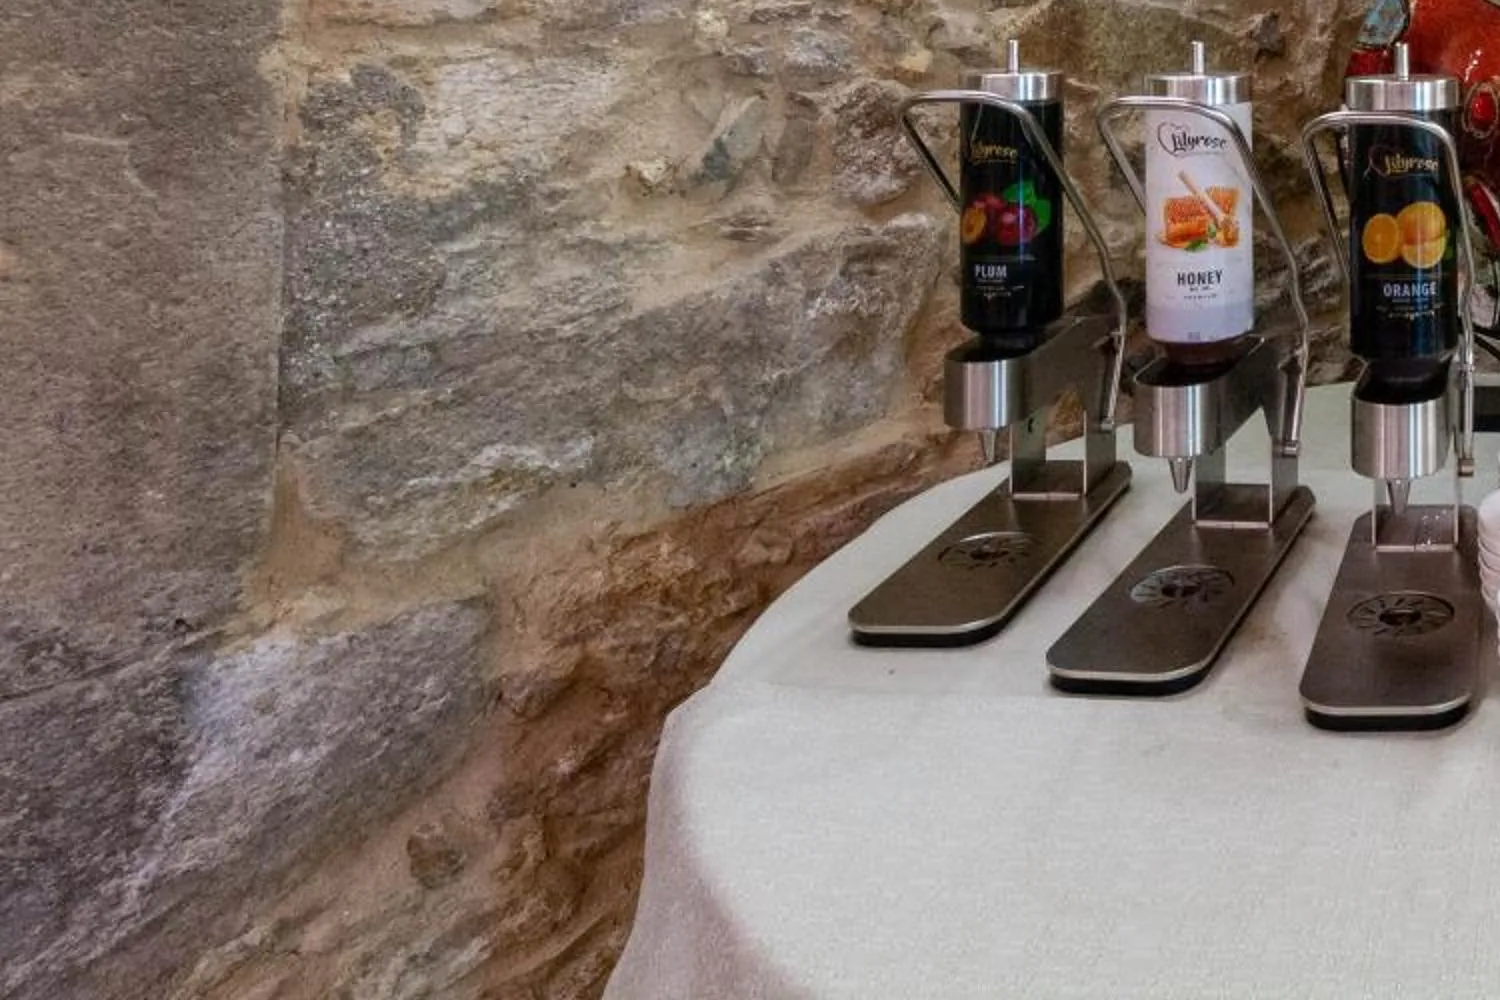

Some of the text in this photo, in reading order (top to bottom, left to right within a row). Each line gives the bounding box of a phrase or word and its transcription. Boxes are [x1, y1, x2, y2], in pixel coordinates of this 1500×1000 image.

[1171, 131, 1228, 152] Lilyrose
[974, 264, 1007, 279] PLUM
[1177, 270, 1222, 286] HONEY
[1383, 281, 1437, 297] ORANGE
